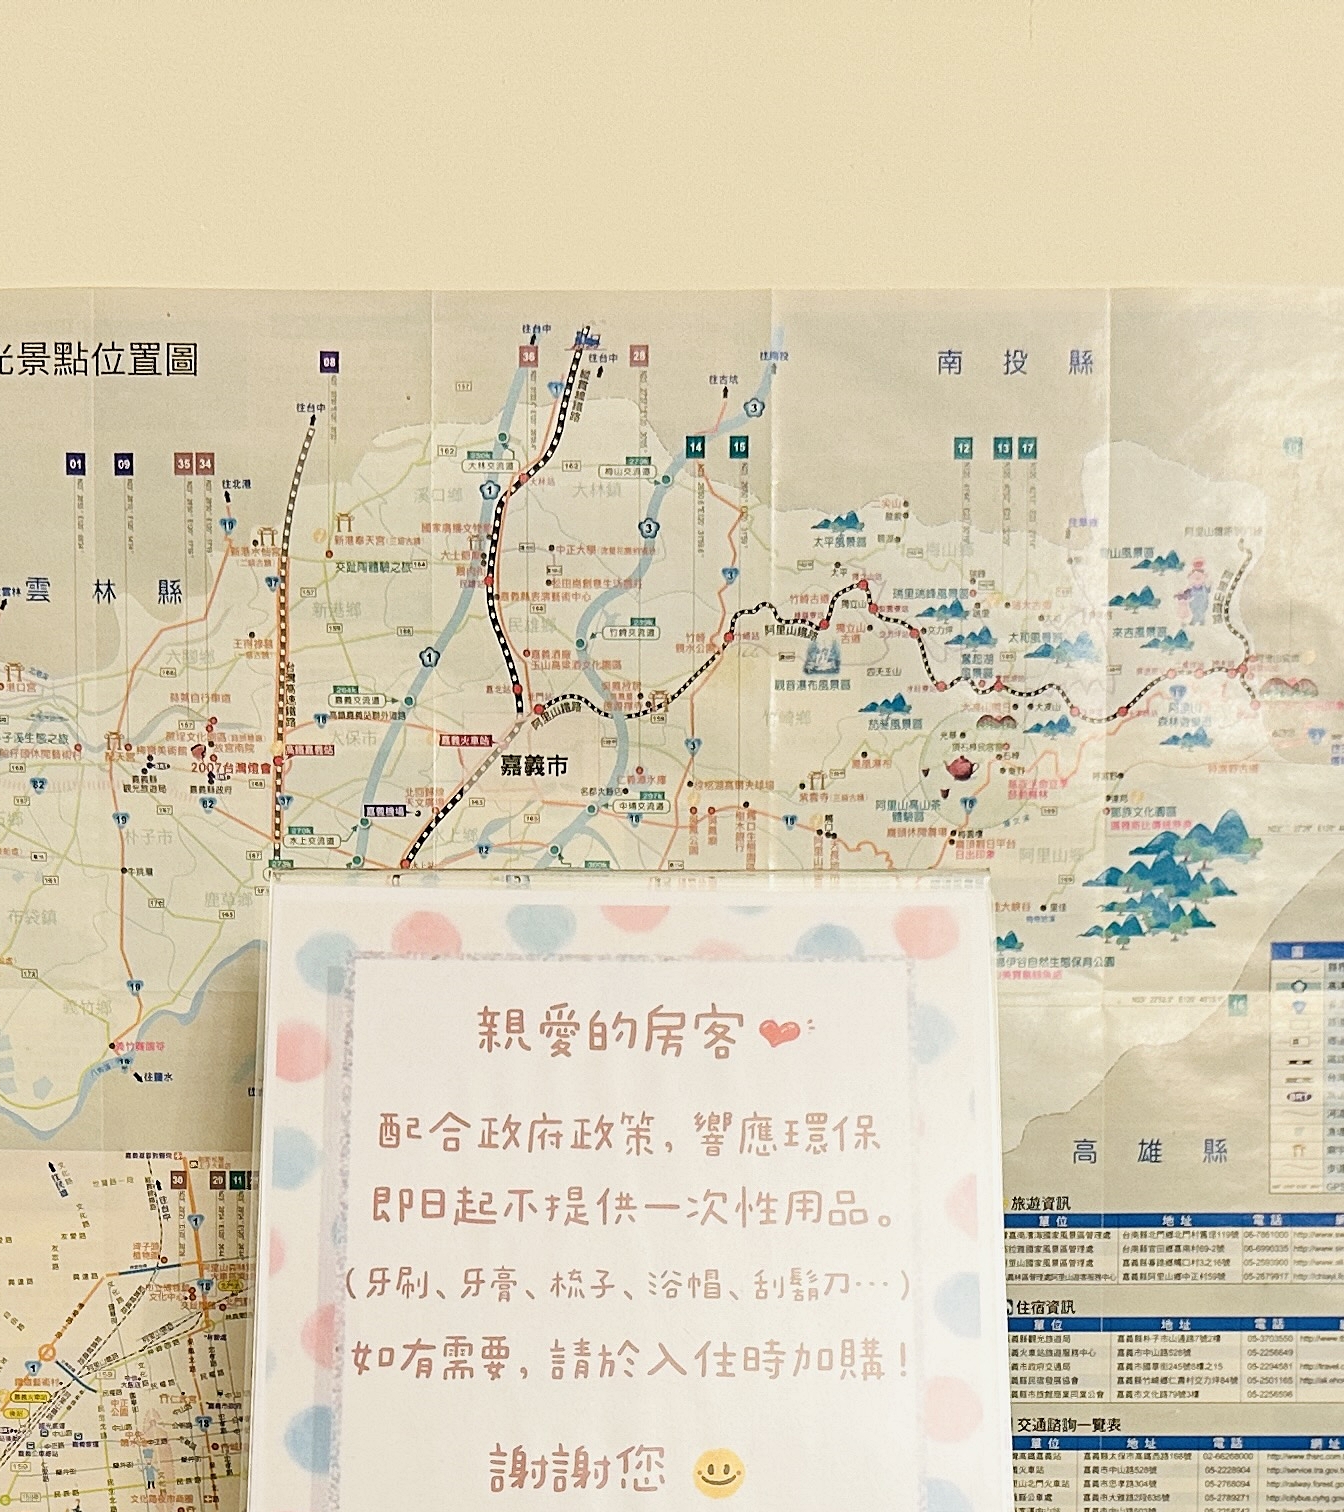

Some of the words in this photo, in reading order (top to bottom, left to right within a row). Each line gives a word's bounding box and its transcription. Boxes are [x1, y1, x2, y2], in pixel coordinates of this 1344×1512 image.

[589, 353, 618, 364] 往台中
[296, 402, 326, 414] 往台中
[222, 478, 251, 490] 往北港
[813, 536, 867, 548] 太平風景區
[334, 695, 380, 707] 嘉義交流道
[500, 755, 569, 777] 嘉義市
[124, 829, 174, 846] 朴子市
[8, 909, 56, 926] 布袋鎮
[476, 1002, 744, 1061] 親愛的房客
[378, 1110, 882, 1157] 配合政府政策，響應環保
[371, 1186, 893, 1228] 即日起不提供一次性用品。
[1011, 1196, 1071, 1211] 旅遊資訊
[1016, 1300, 1076, 1315] 住宿資訊
[351, 1334, 909, 1382] 如有需要，請於入住時加購！
[1017, 1418, 1121, 1432] 交通諮詢一覽表
[488, 1443, 667, 1493] 謝謝您
